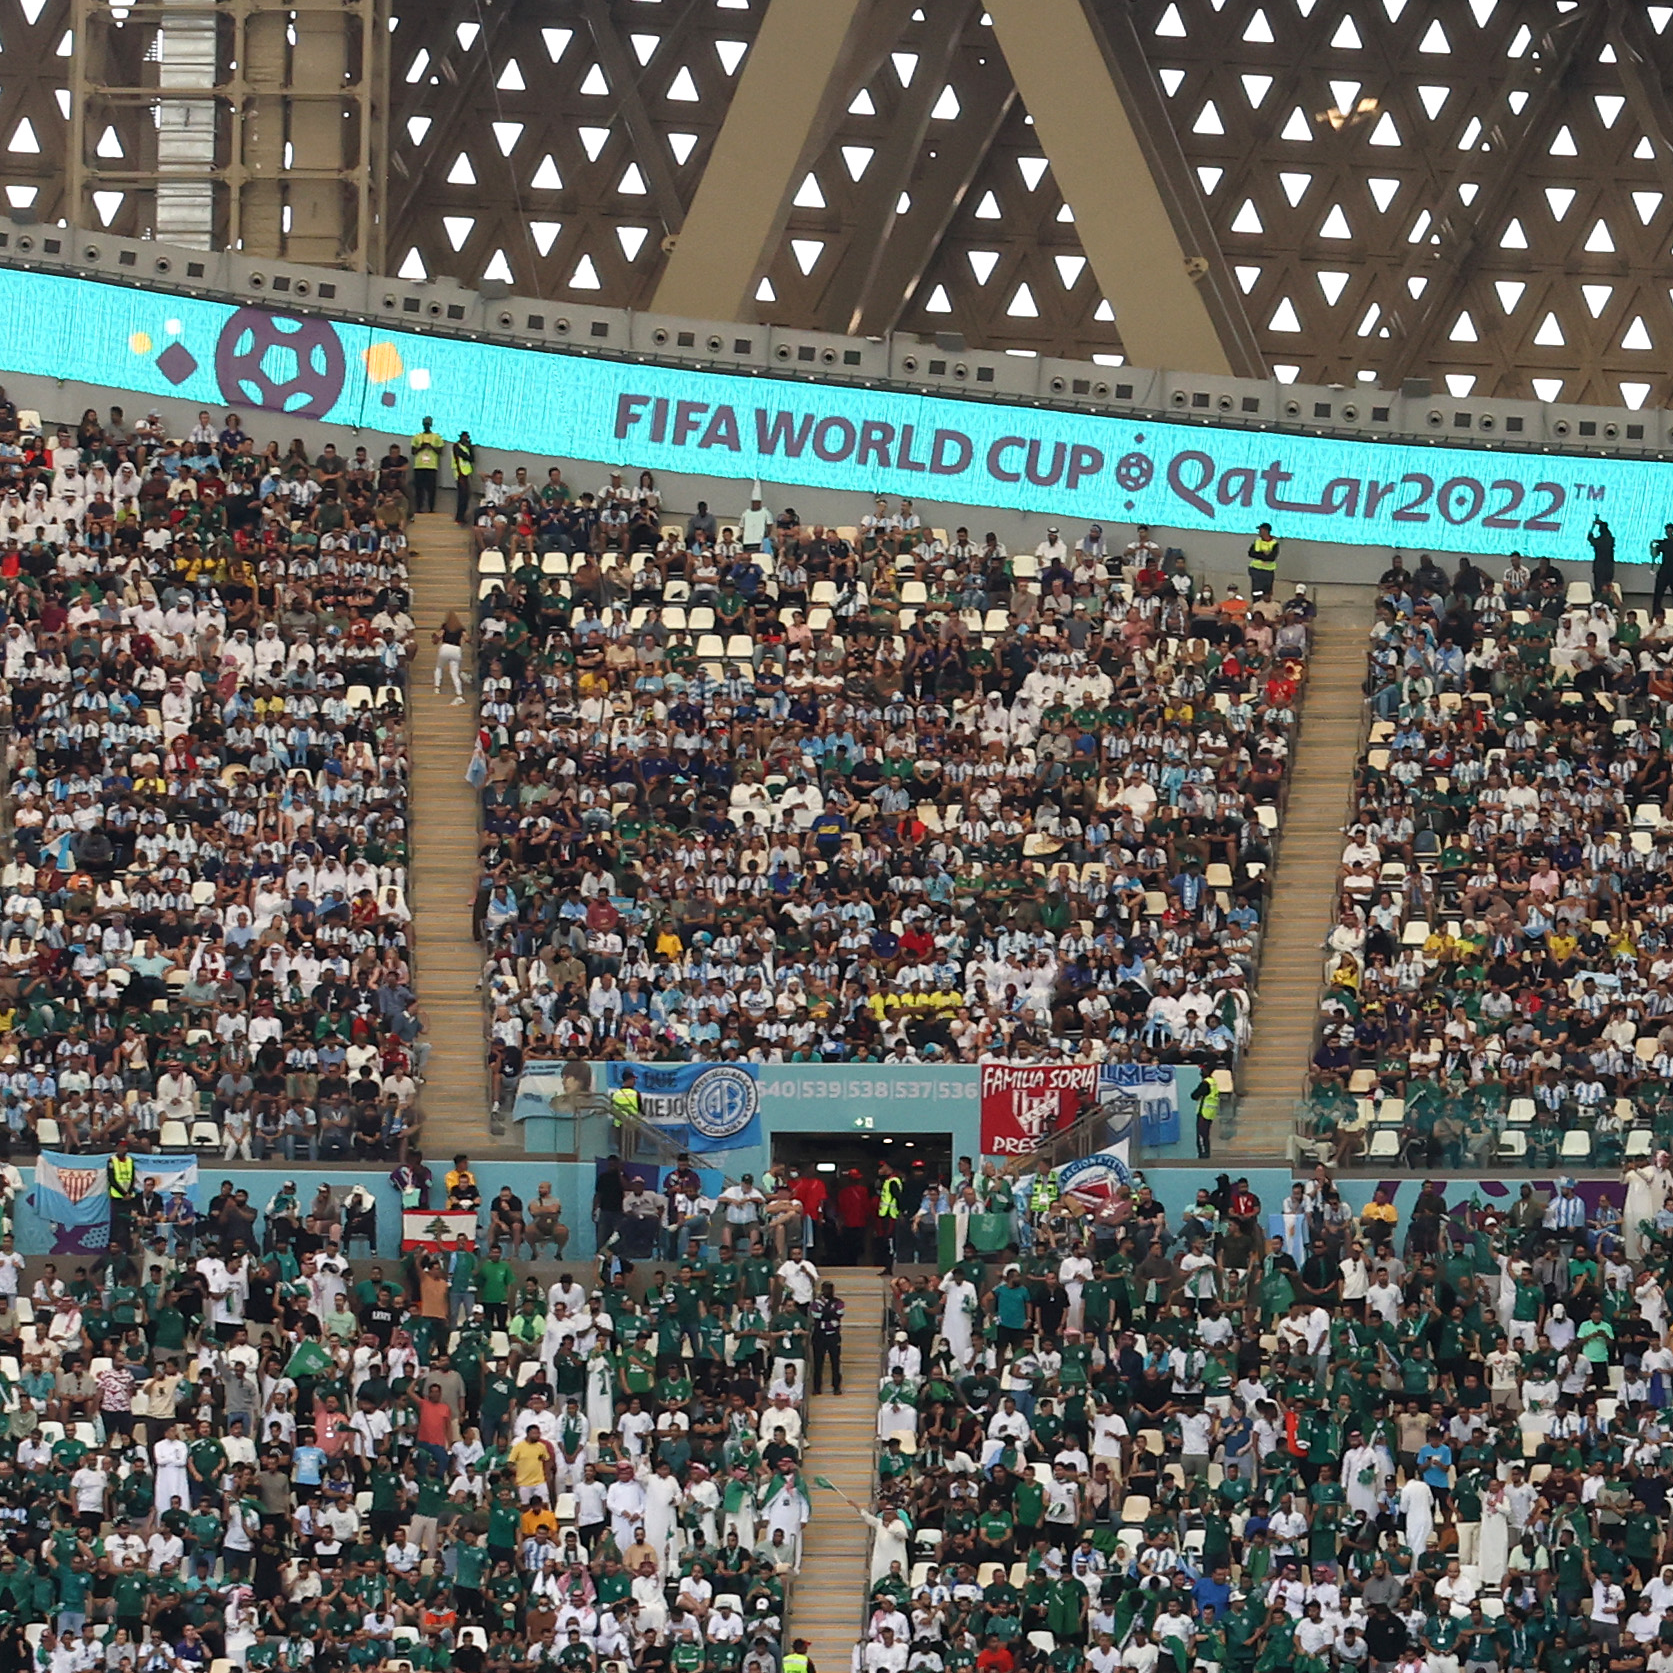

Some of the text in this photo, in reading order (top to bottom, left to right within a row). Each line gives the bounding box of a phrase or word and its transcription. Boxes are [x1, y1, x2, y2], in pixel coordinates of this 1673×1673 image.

[614, 392, 742, 452] FIFA
[754, 408, 974, 476] WORLD
[986, 435, 1105, 490] CUP
[802, 1080, 841, 1099] 539
[849, 1081, 888, 1099] 538
[896, 1081, 933, 1099] 537
[939, 1081, 978, 1099] 536
[983, 1065, 1096, 1098] FAMILIA SORIA
